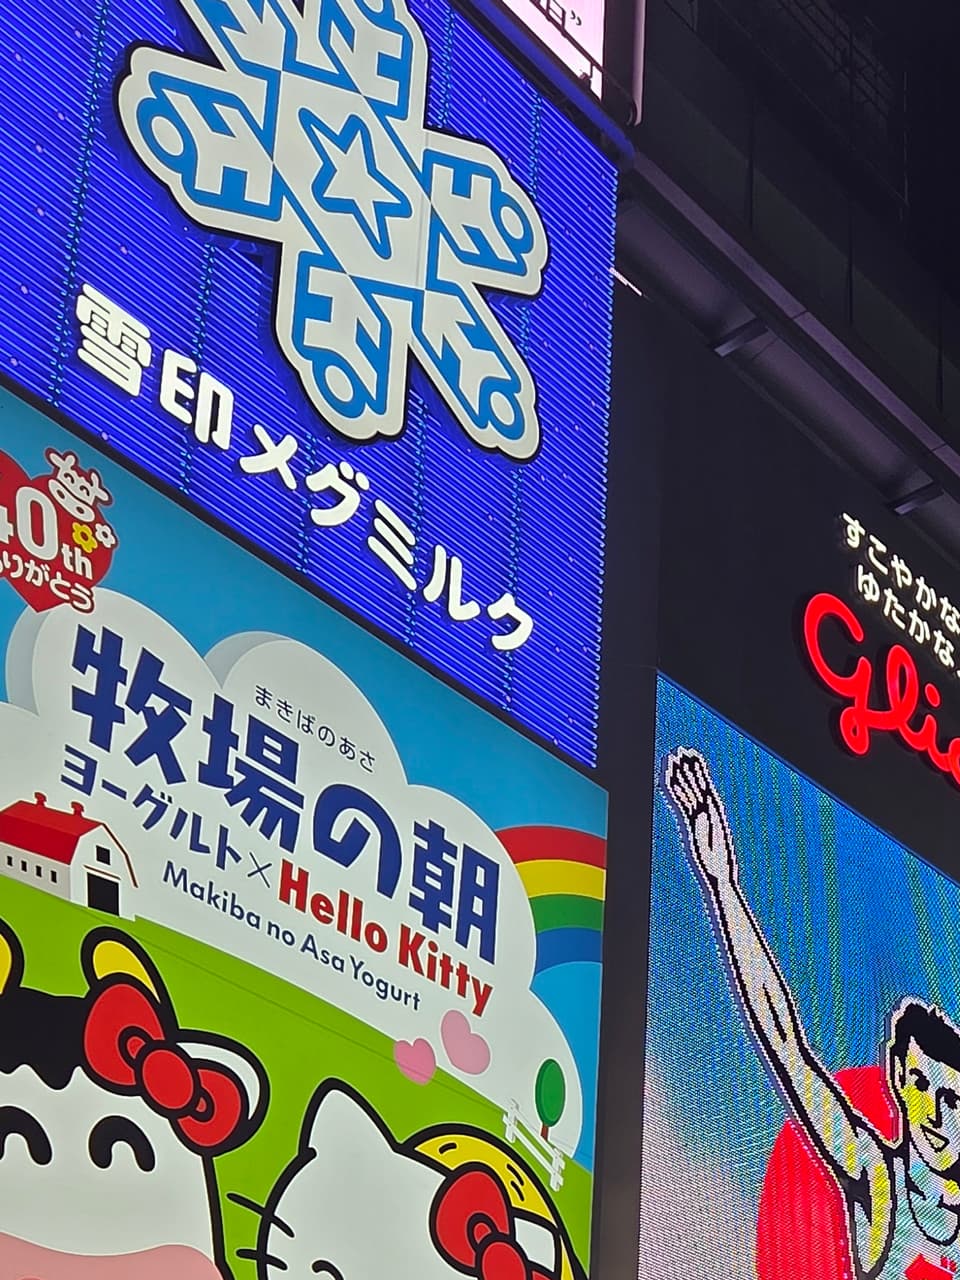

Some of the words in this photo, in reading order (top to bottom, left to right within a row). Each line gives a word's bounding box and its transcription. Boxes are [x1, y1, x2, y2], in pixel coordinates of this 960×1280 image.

[76, 282, 534, 651] 雪印メグミルク
[0, 551, 92, 613] りがとう
[71, 624, 500, 965] 牧場の朝
[255, 684, 376, 773] まきばのあさ
[163, 860, 261, 926] Makiba
[267, 919, 296, 948] no
[301, 933, 345, 973] Asa
[349, 951, 421, 1012] Yogurt
[279, 858, 388, 953] Hello
[398, 923, 493, 1017] Kitty
